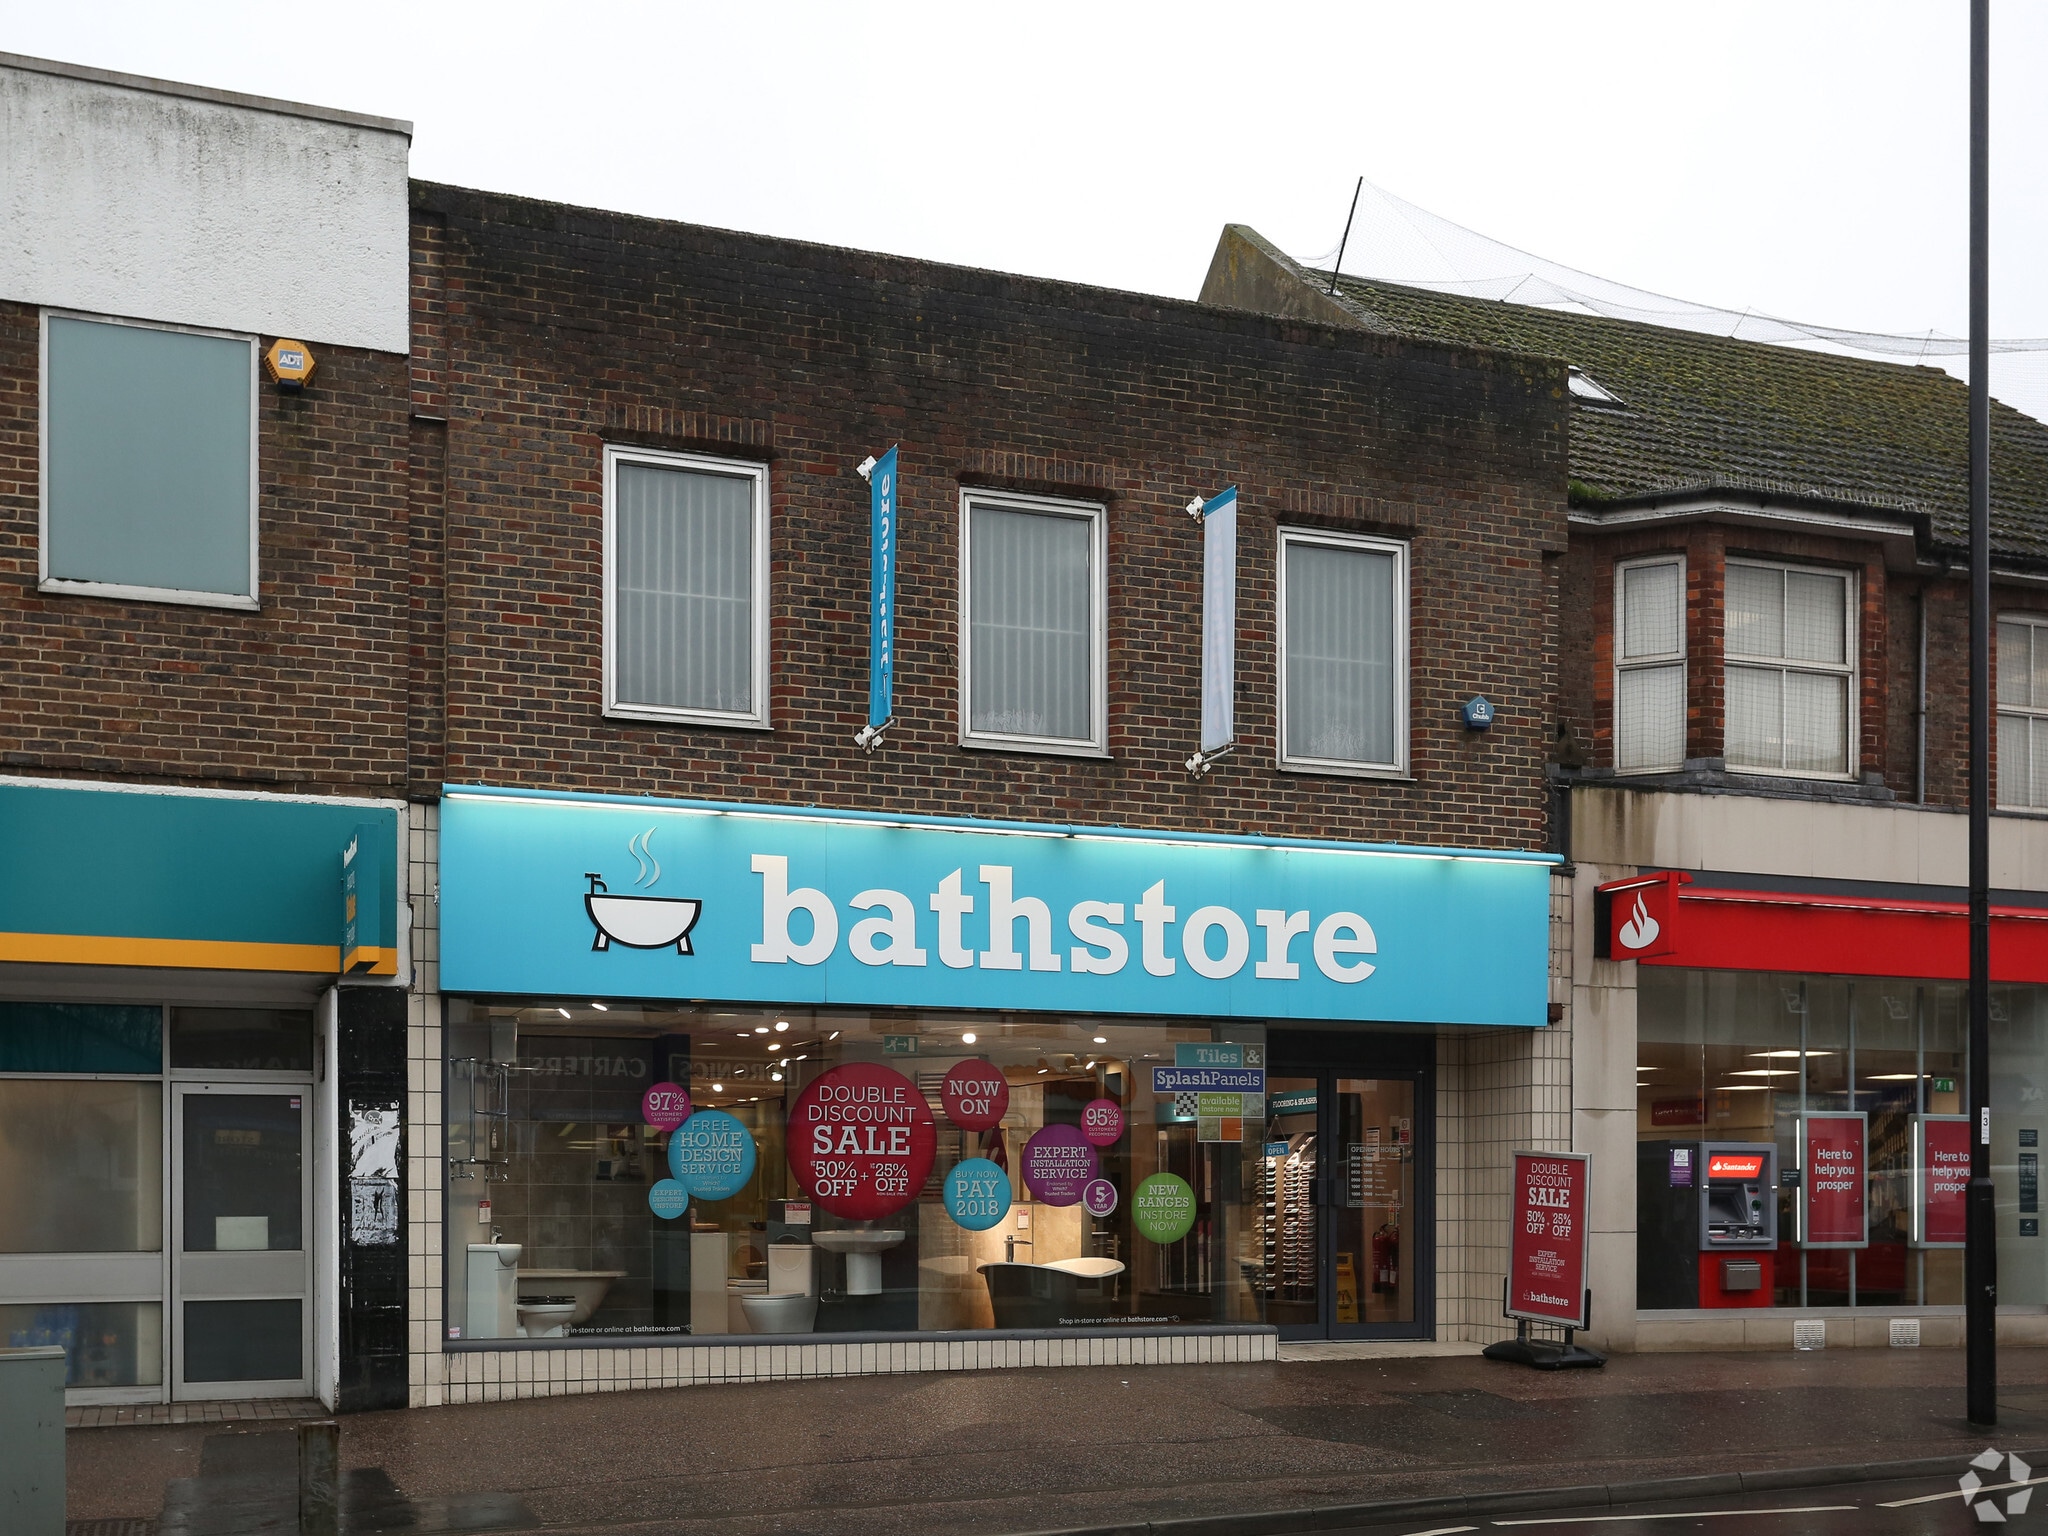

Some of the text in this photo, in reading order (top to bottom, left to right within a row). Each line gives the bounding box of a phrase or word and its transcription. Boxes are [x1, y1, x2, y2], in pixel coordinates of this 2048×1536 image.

[280, 354, 303, 365] ADT
[751, 854, 1377, 983] bathstore
[1197, 1049, 1260, 1063] Tiles &
[1157, 1071, 1260, 1088] SplashPanels
[819, 1085, 906, 1103] DOUBLE
[950, 1080, 1000, 1096] NOW
[649, 1092, 684, 1111] 97%
[1201, 1097, 1239, 1105] available
[960, 1100, 990, 1115] ON
[808, 1105, 916, 1123] DISCOUNT
[1086, 1108, 1118, 1126] 95%
[692, 1120, 730, 1131] FREE
[1983, 1118, 1988, 1126] 3
[680, 1132, 742, 1147] HOME
[813, 1125, 911, 1155] SALE
[681, 1149, 742, 1162] DESIGN
[1033, 1147, 1087, 1158] EXPERT
[1817, 1149, 1852, 1159] Here to
[1935, 1152, 1969, 1161] Here to
[681, 1163, 741, 1174] SERVICE
[815, 1161, 857, 1178] 50%
[875, 1163, 908, 1177] 25%
[1531, 1163, 1568, 1175] DOUBLE
[1722, 1162, 1757, 1171] Santander
[1815, 1163, 1854, 1177] help you
[1932, 1165, 1970, 1179] help you
[1033, 1169, 1087, 1179] SERVICE
[875, 1178, 908, 1191] OFF
[1527, 1175, 1573, 1187] DISCOUNT
[1817, 1181, 1853, 1192] prosper
[815, 1179, 857, 1196] OFF
[956, 1181, 999, 1198] PAY
[1149, 1185, 1179, 1195] NEW
[1934, 1183, 1966, 1194] prospe
[1095, 1187, 1105, 1203] 5
[1528, 1187, 1570, 1208] SALE
[1138, 1197, 1189, 1207] RANGES
[956, 1201, 999, 1216] 2018
[1141, 1211, 1187, 1220] INSTORE
[1526, 1211, 1545, 1223] 50%
[1552, 1213, 1571, 1226] 25%
[1150, 1222, 1178, 1230] NOW
[1526, 1223, 1545, 1234] OFF
[1552, 1225, 1571, 1237] OFF
[1538, 1250, 1557, 1258] EXPERT
[1529, 1256, 1565, 1266] INSTALLATION
[1536, 1264, 1557, 1272] SERVICE
[1530, 1292, 1569, 1306] bathstore
